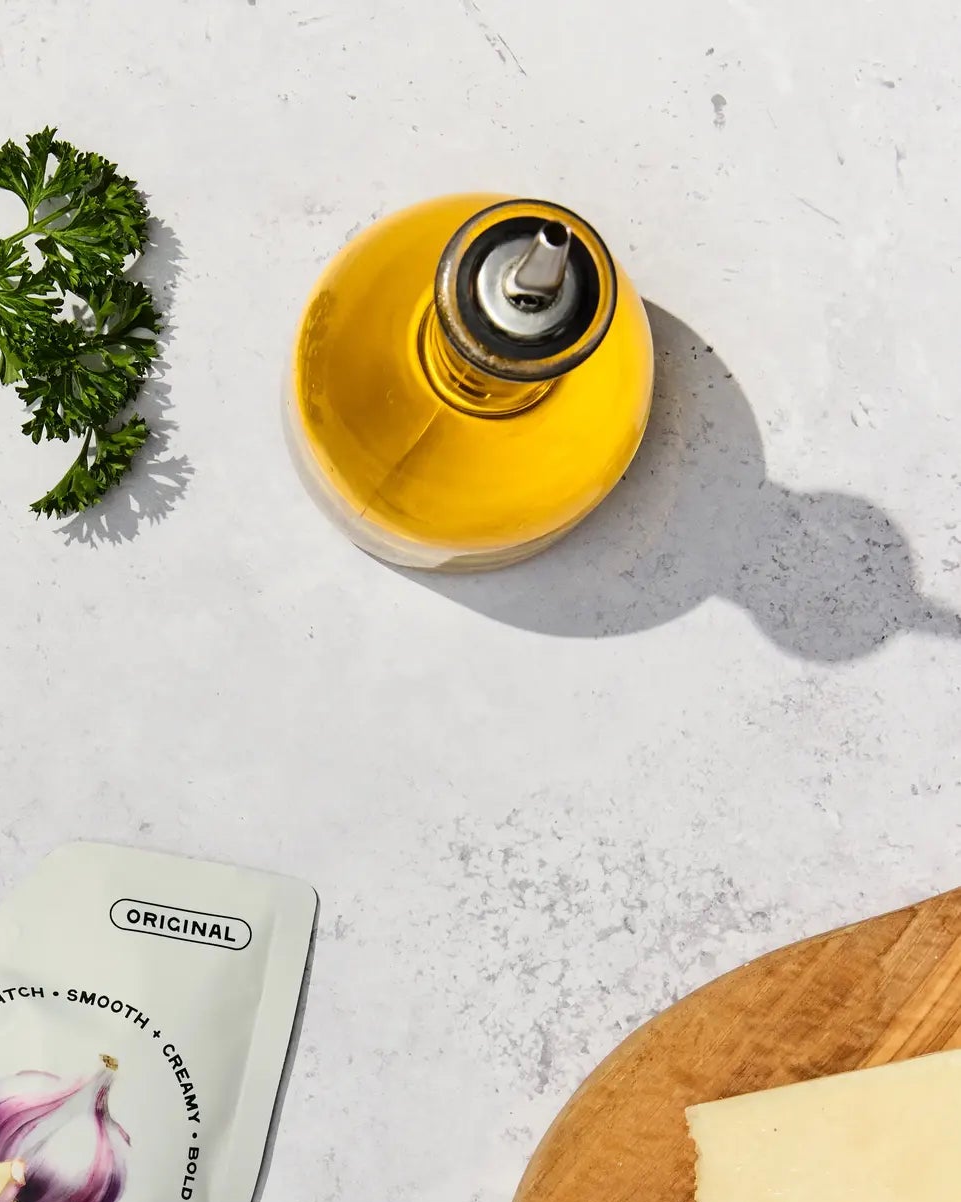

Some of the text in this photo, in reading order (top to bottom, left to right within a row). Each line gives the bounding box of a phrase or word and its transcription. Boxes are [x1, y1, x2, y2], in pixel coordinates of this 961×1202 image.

[126, 908, 236, 943] ORIGINAL
[66, 988, 151, 1030] SMOOTH
[162, 1043, 201, 1124] CREAMY
[180, 1146, 200, 1201] BOLD
